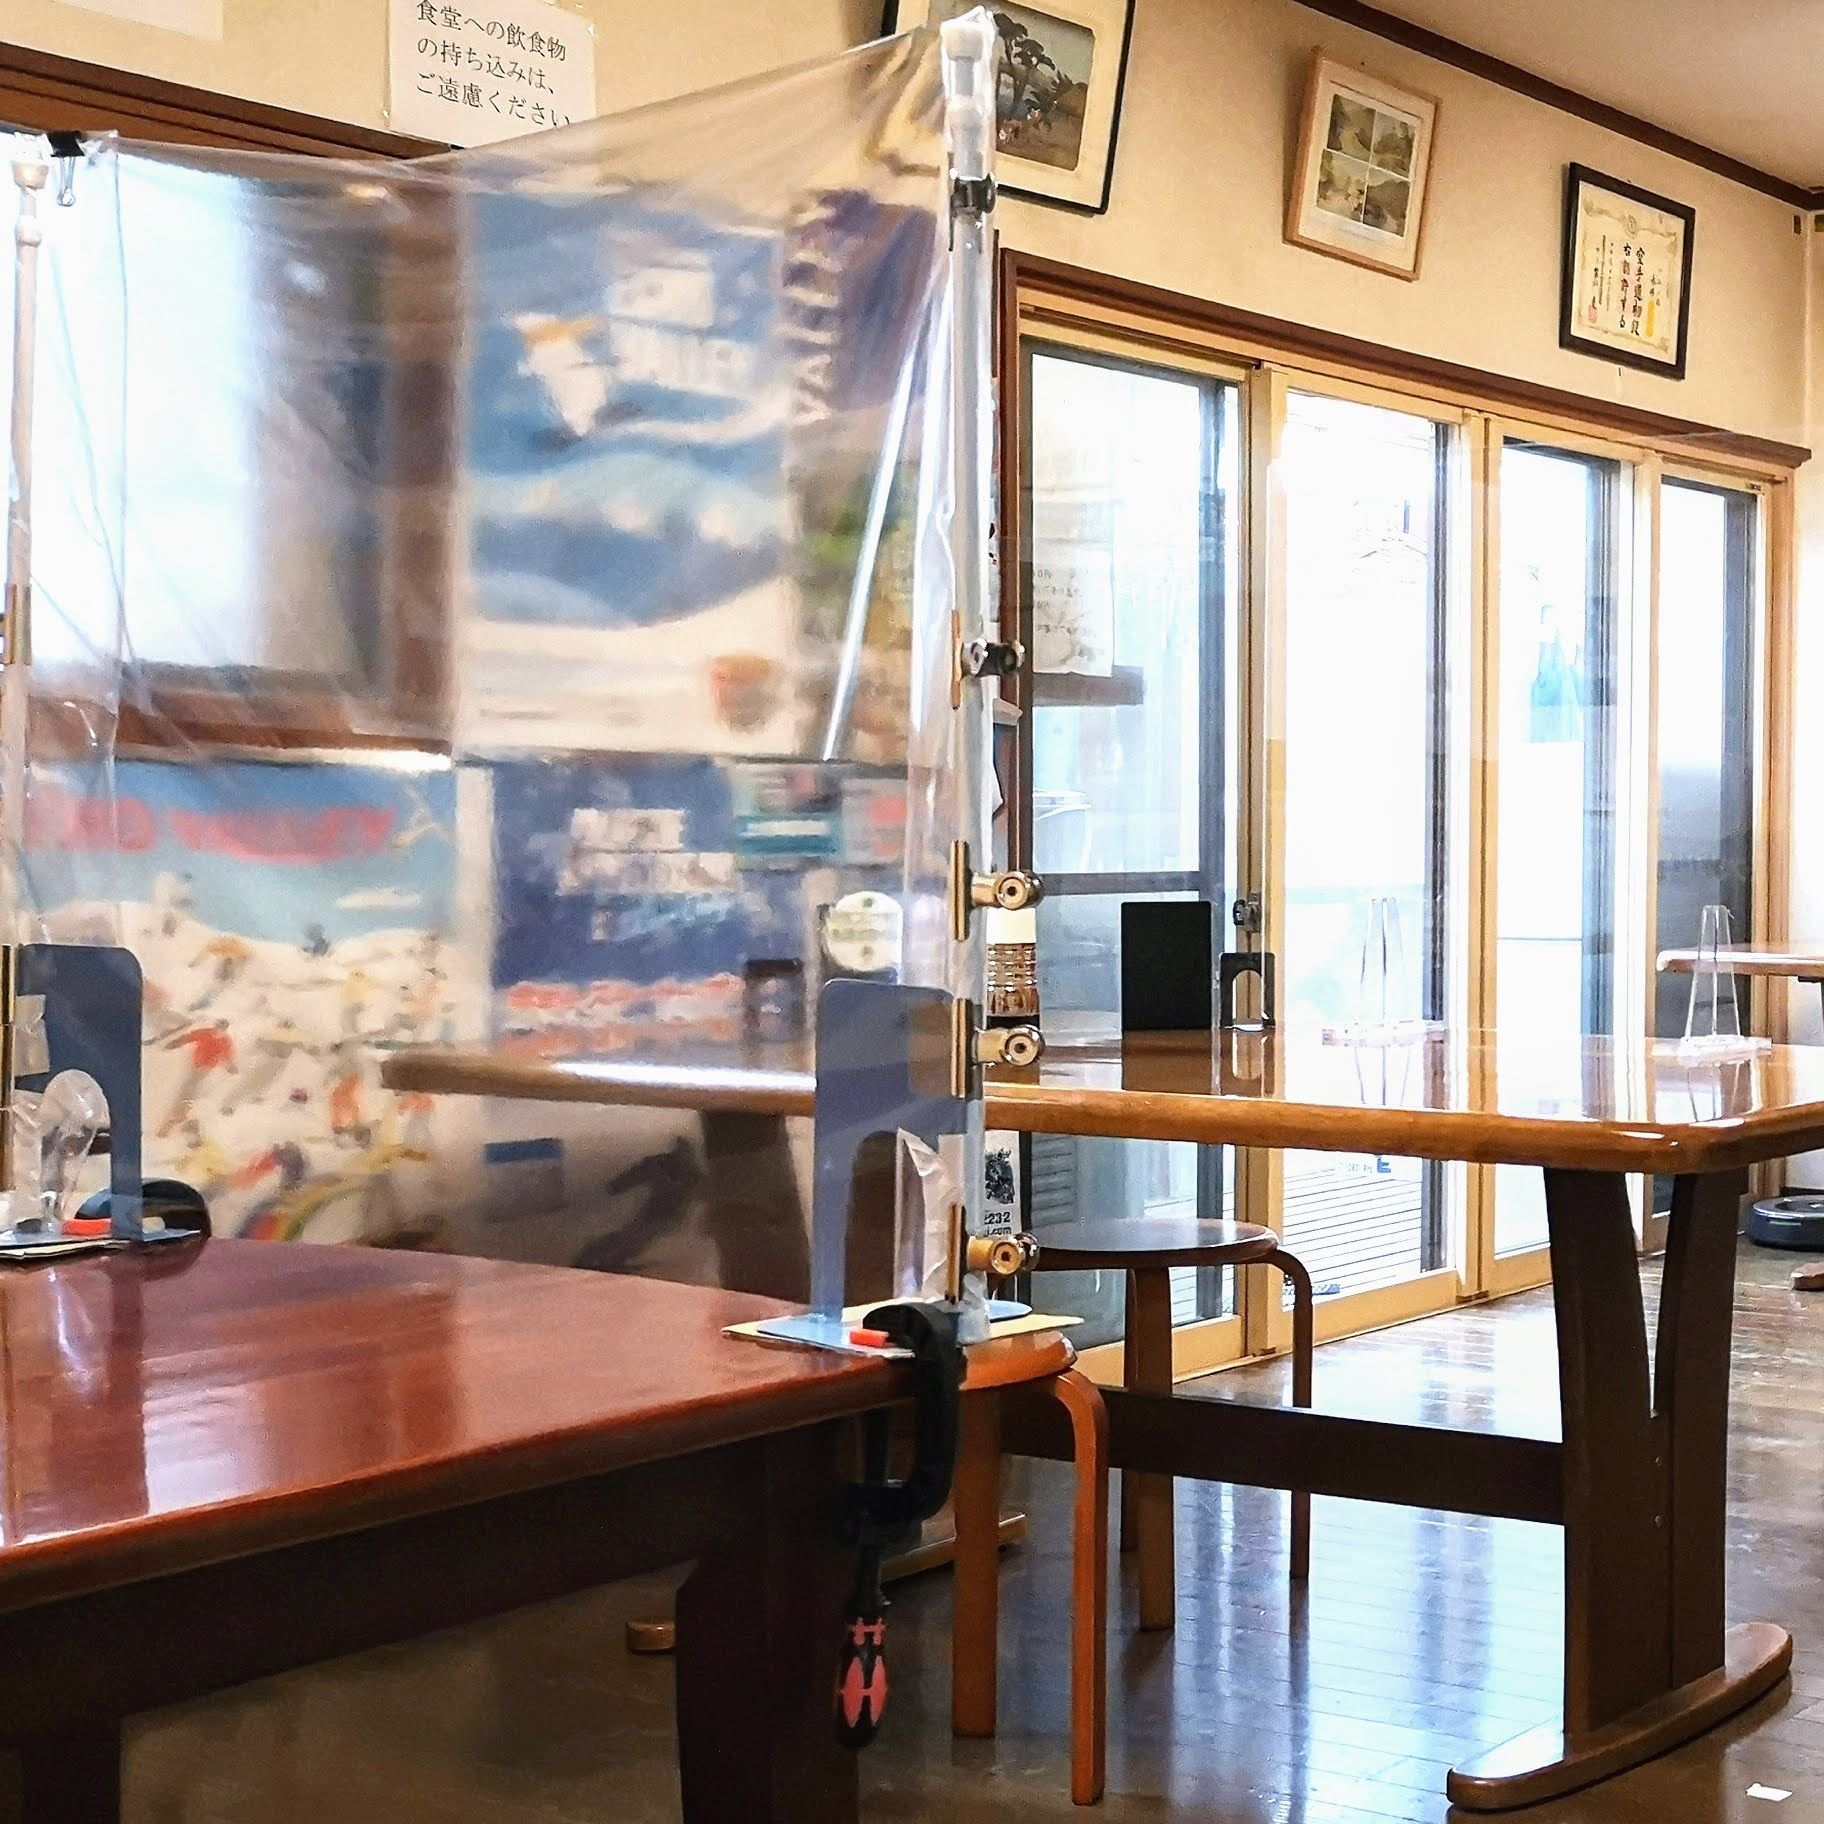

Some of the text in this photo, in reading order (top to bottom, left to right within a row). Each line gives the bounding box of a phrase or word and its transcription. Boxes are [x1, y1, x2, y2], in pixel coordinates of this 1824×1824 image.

[416, 0, 567, 61] 食堂への飲食物
[417, 38, 554, 94] の持ち込みは、
[416, 73, 571, 127] ご遠慮ください
